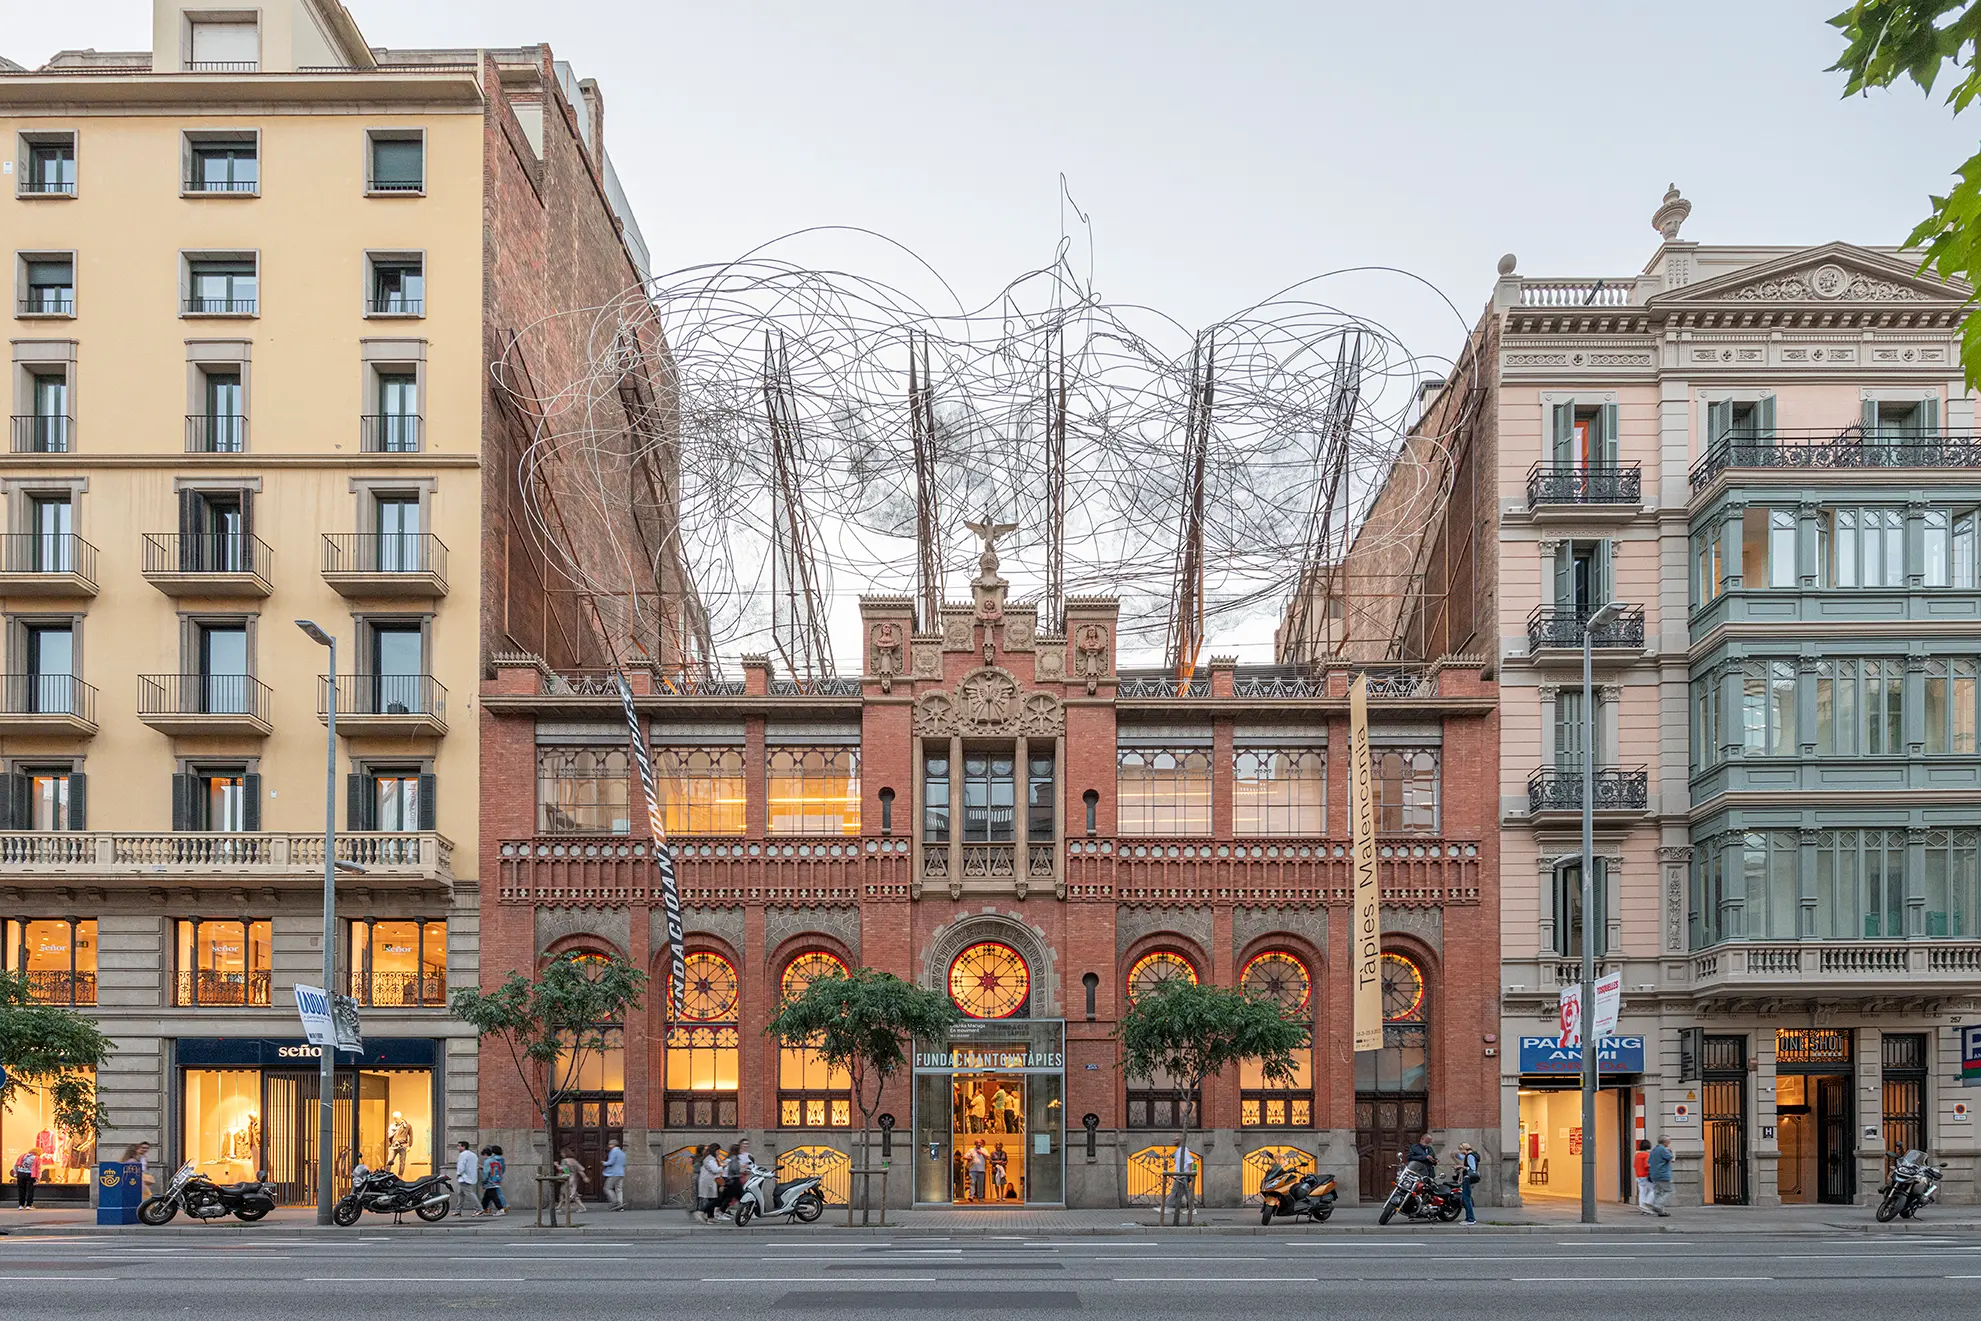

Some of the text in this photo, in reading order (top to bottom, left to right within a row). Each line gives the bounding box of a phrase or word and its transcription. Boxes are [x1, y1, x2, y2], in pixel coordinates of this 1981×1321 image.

[1356, 724, 1379, 991] Tàpies. Malenconia
[1780, 1035, 1844, 1051] ONE SHOT
[279, 1044, 323, 1057] seño
[1536, 1062, 1628, 1071] SORDA
[1765, 1127, 1772, 1136] H
